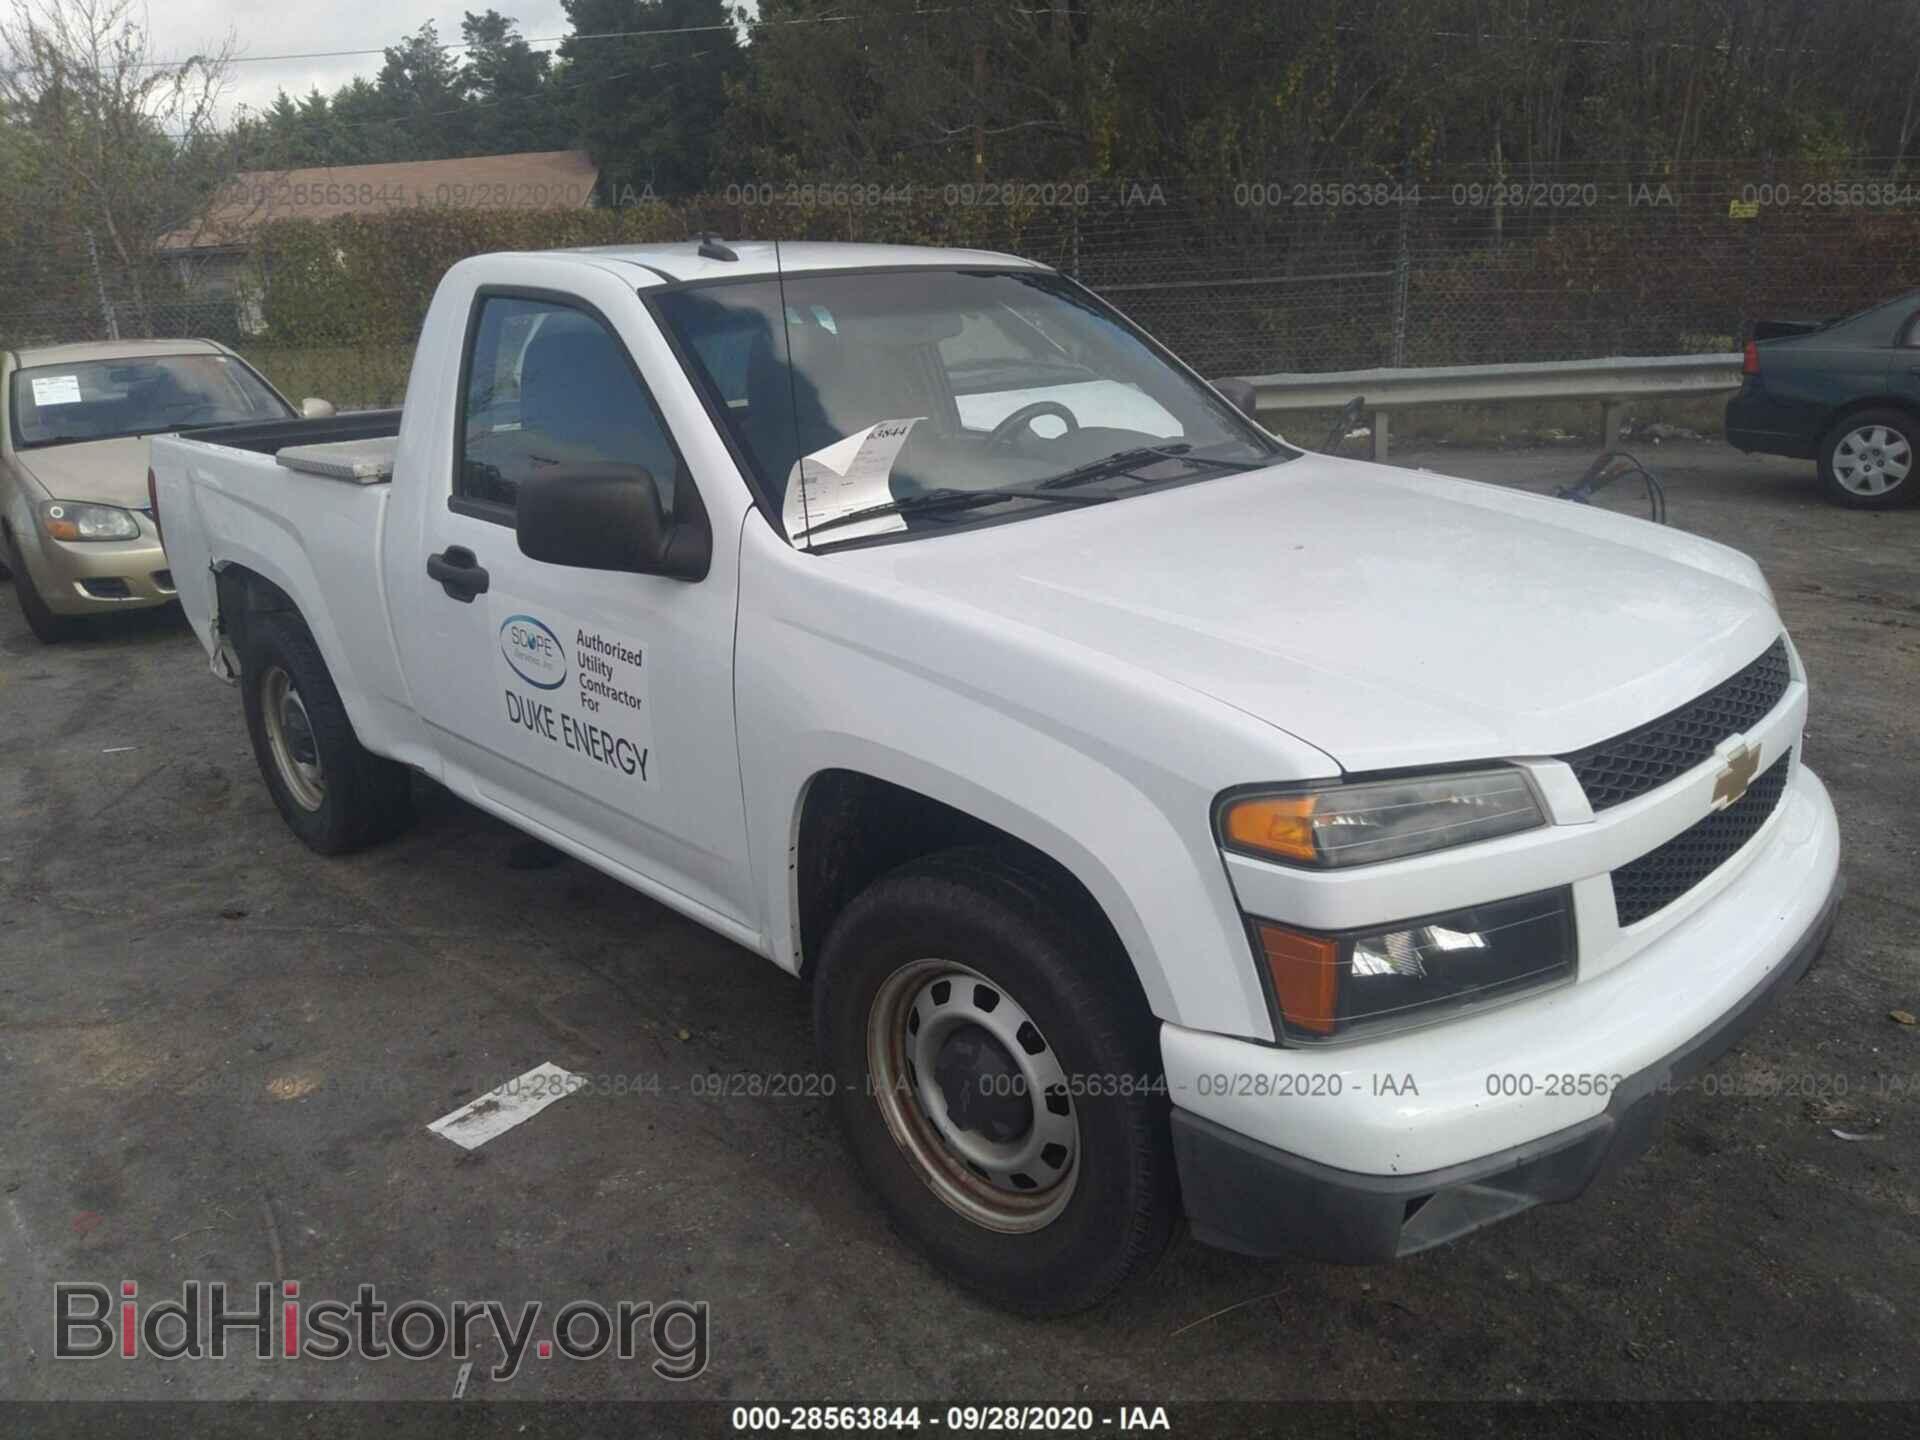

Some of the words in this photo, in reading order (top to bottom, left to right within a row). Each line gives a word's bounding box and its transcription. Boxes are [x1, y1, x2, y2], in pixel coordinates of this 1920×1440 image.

[577, 628, 642, 667] Authorized
[578, 651, 613, 682] Utility
[579, 673, 642, 709] Contractor
[580, 692, 600, 712] For
[506, 690, 557, 741] DUKE
[561, 713, 648, 781] ENERGY
